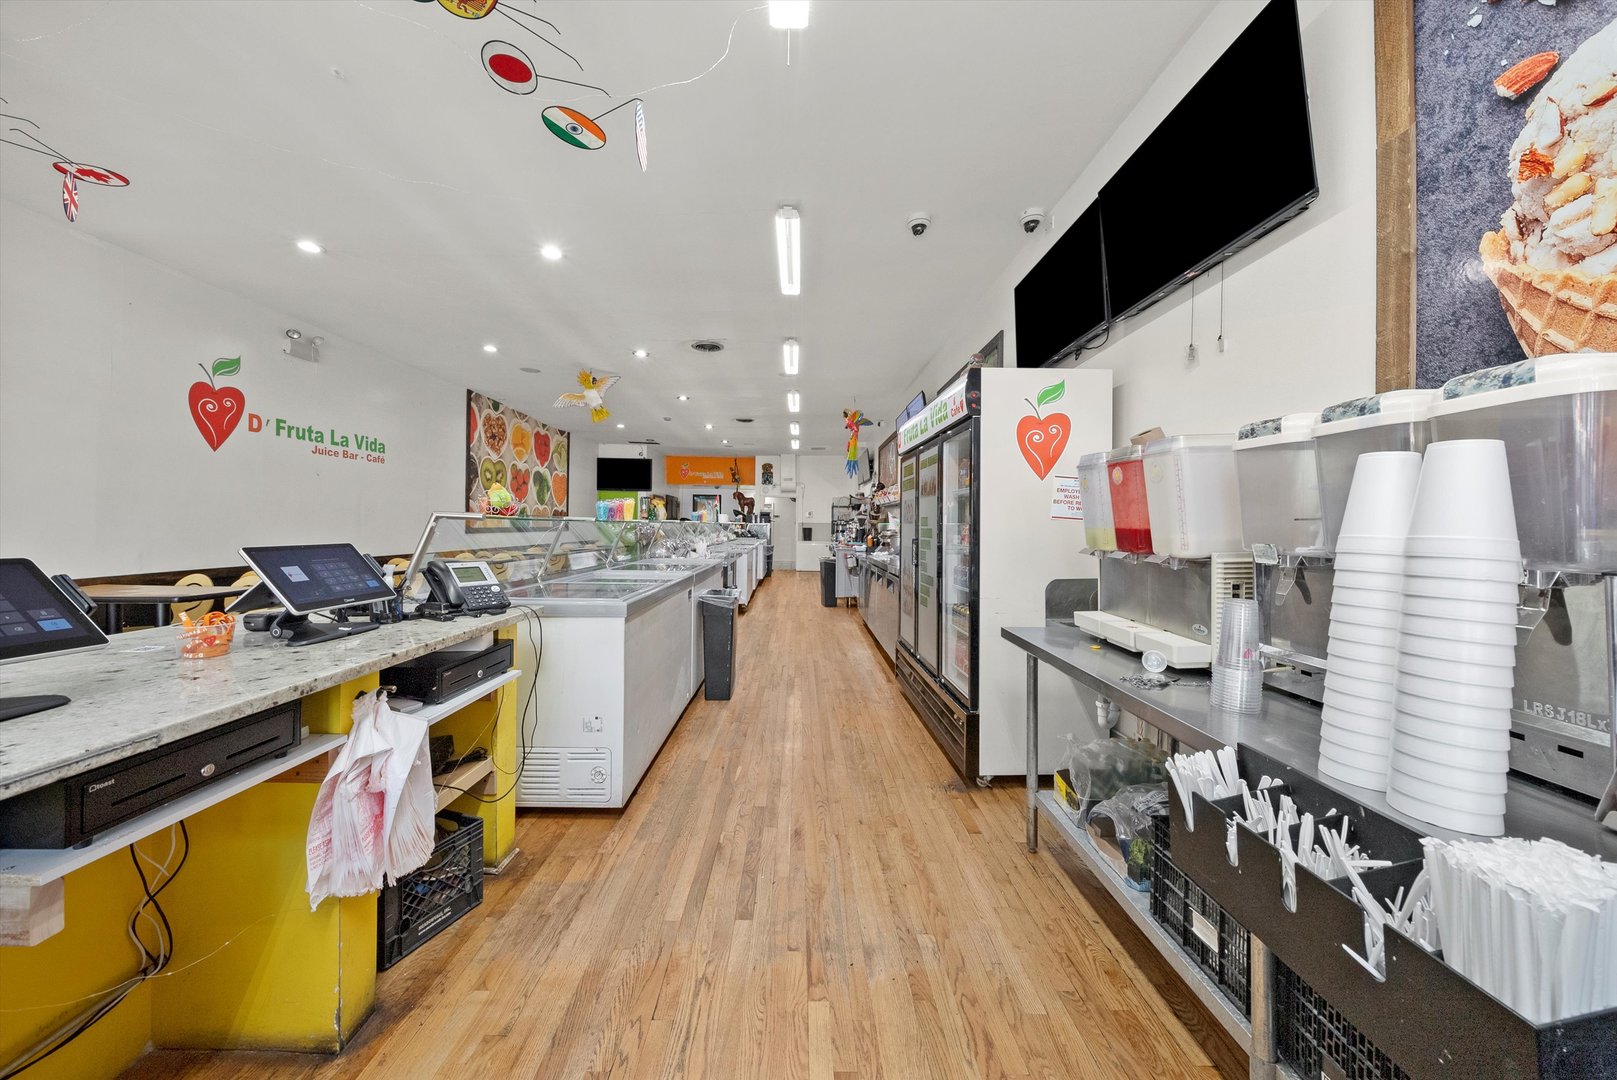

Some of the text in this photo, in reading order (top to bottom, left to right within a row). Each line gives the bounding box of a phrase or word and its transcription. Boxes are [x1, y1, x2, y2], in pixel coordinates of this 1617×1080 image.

[275, 418, 325, 443] Fruta
[330, 429, 349, 448] La
[354, 434, 386, 454] Vida
[903, 424, 919, 445] Fruta
[919, 416, 929, 435] La
[930, 400, 949, 428] Vida
[311, 446, 340, 458] Juice
[342, 449, 359, 460] Bar
[366, 453, 386, 464] Café
